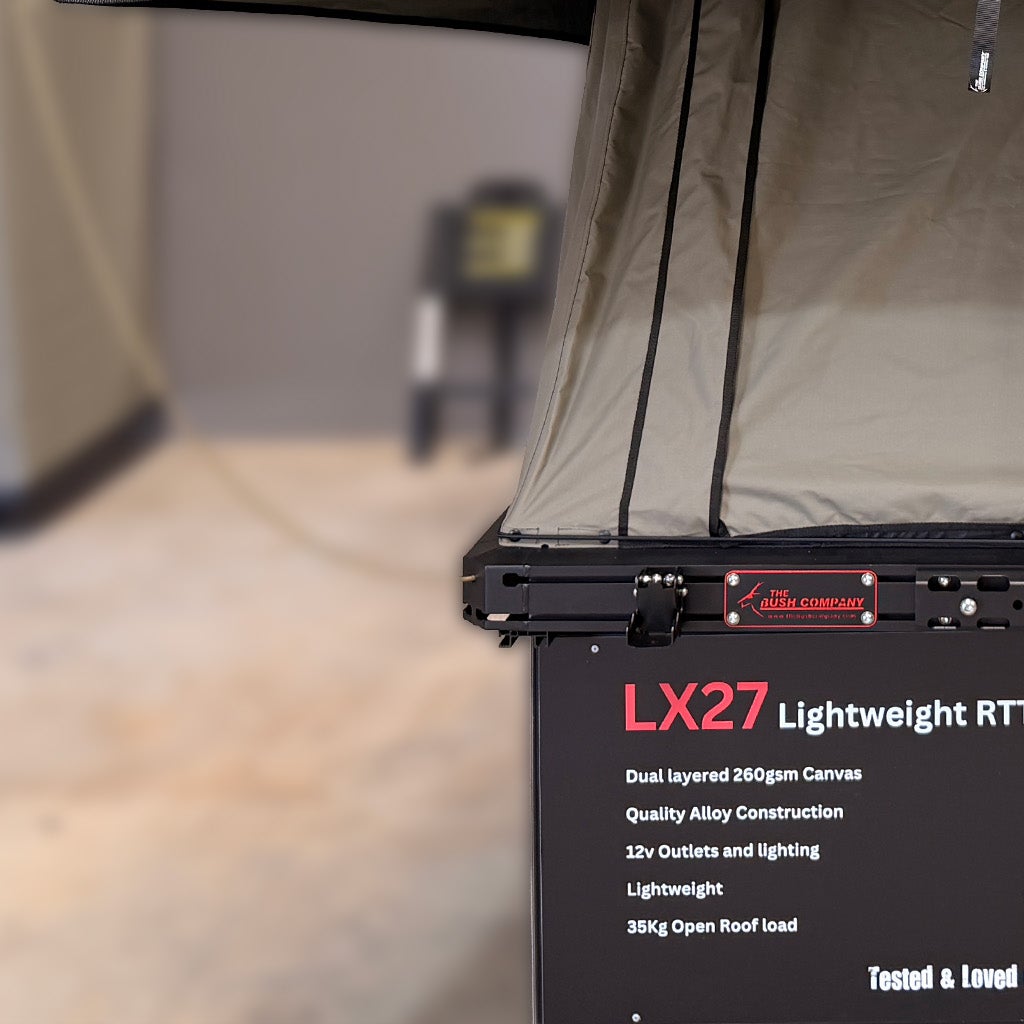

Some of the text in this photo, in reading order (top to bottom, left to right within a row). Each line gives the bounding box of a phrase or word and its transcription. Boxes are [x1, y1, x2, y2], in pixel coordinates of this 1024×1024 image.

[760, 597, 865, 608] BUSH COMPANY
[769, 589, 790, 598] THE
[624, 681, 769, 731] LX27
[779, 699, 967, 736] Lightweight
[625, 766, 863, 786] Dual layered 260gsm Canvas
[625, 804, 844, 824] Quality Alloy Construction
[625, 841, 820, 861] 12v Outlets and lighting
[627, 881, 723, 899] Lightweight
[626, 917, 798, 937] 35Kg Open Roof load
[868, 964, 933, 991] Tested
[939, 967, 955, 989] &
[961, 964, 1018, 990] Loved
